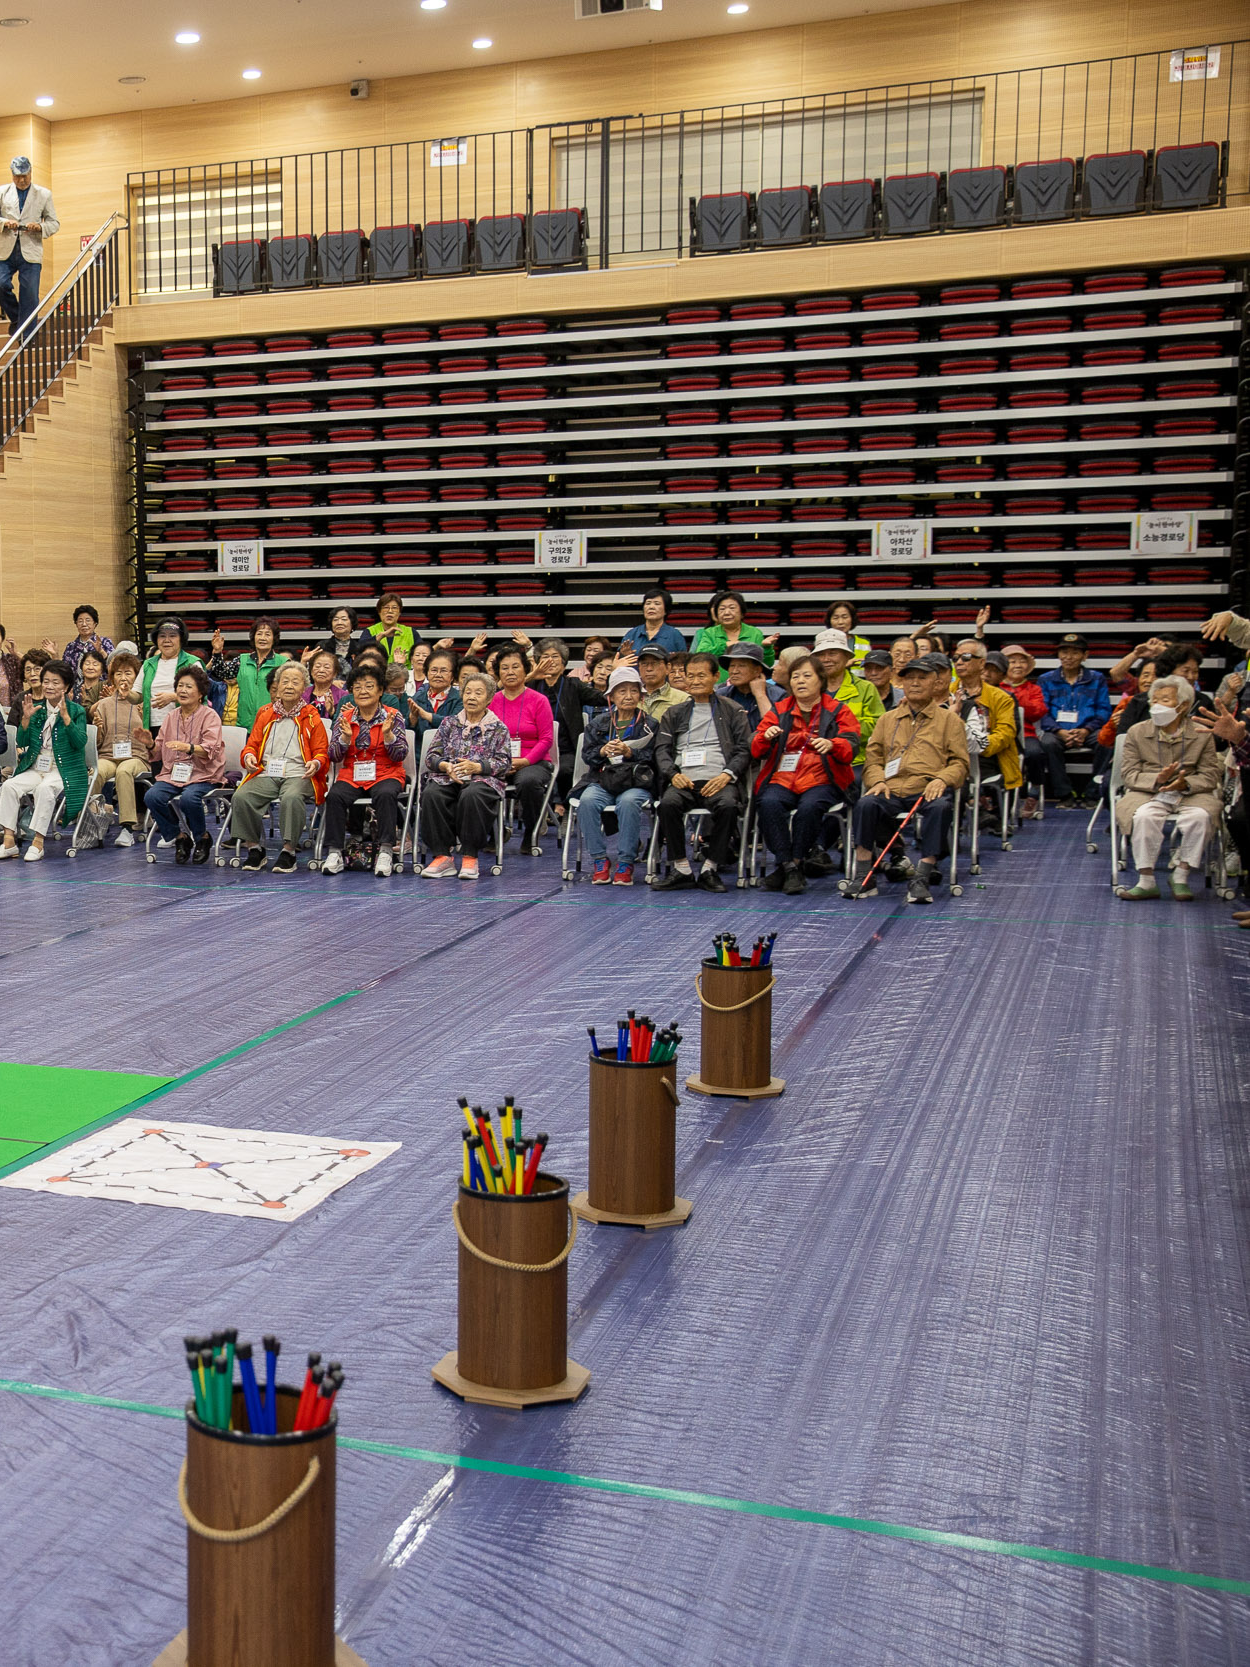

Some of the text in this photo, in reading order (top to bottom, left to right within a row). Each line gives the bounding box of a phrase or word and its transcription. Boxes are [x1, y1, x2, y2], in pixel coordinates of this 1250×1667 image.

[890, 537, 913, 546] 아차산
[548, 547, 573, 555] 구의2동
[890, 547, 913, 556] 경로당
[231, 556, 250, 564] 래미안
[551, 556, 571, 564] 경로당
